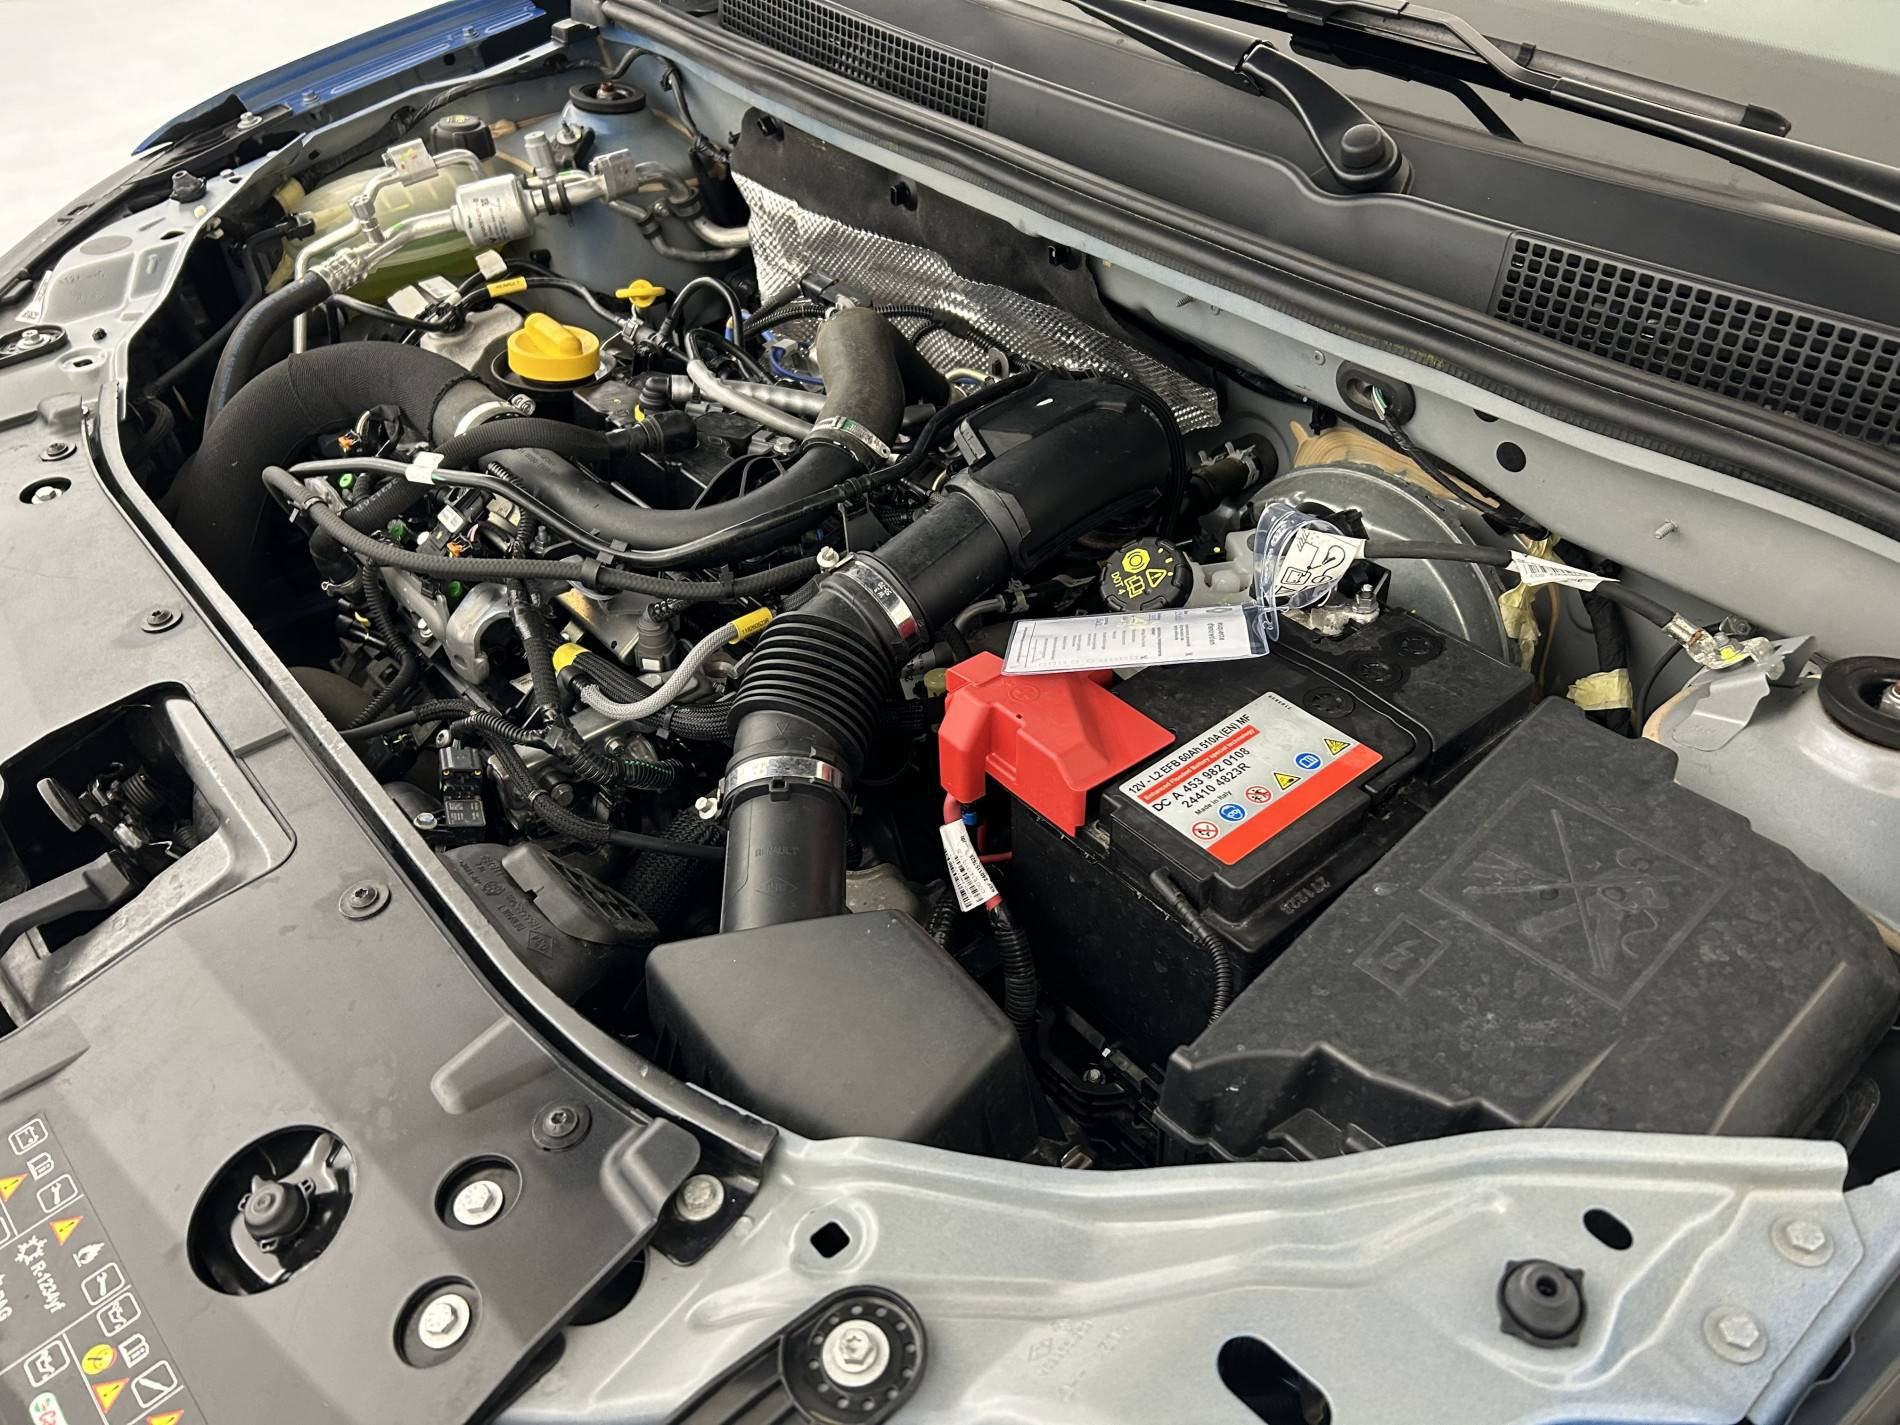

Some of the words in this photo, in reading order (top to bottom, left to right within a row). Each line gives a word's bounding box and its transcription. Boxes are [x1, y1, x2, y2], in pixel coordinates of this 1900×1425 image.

[1111, 571, 1124, 588] DOT
[1129, 782, 1146, 794] 12V
[1149, 771, 1162, 781] L2
[1160, 759, 1181, 774] EFB
[1178, 746, 1202, 762] 60Ah
[1200, 734, 1221, 749] 510A
[1219, 722, 1240, 738] (EN)
[1236, 714, 1251, 725] MF
[1172, 791, 1184, 801] A
[1182, 777, 1204, 793] 453
[1202, 764, 1225, 779] 982
[1222, 747, 1251, 766] 0108
[1181, 784, 1216, 808] 24410
[1215, 762, 1251, 787] 4823R
[1195, 803, 1213, 815] Made
[1217, 791, 1233, 801] Italy
